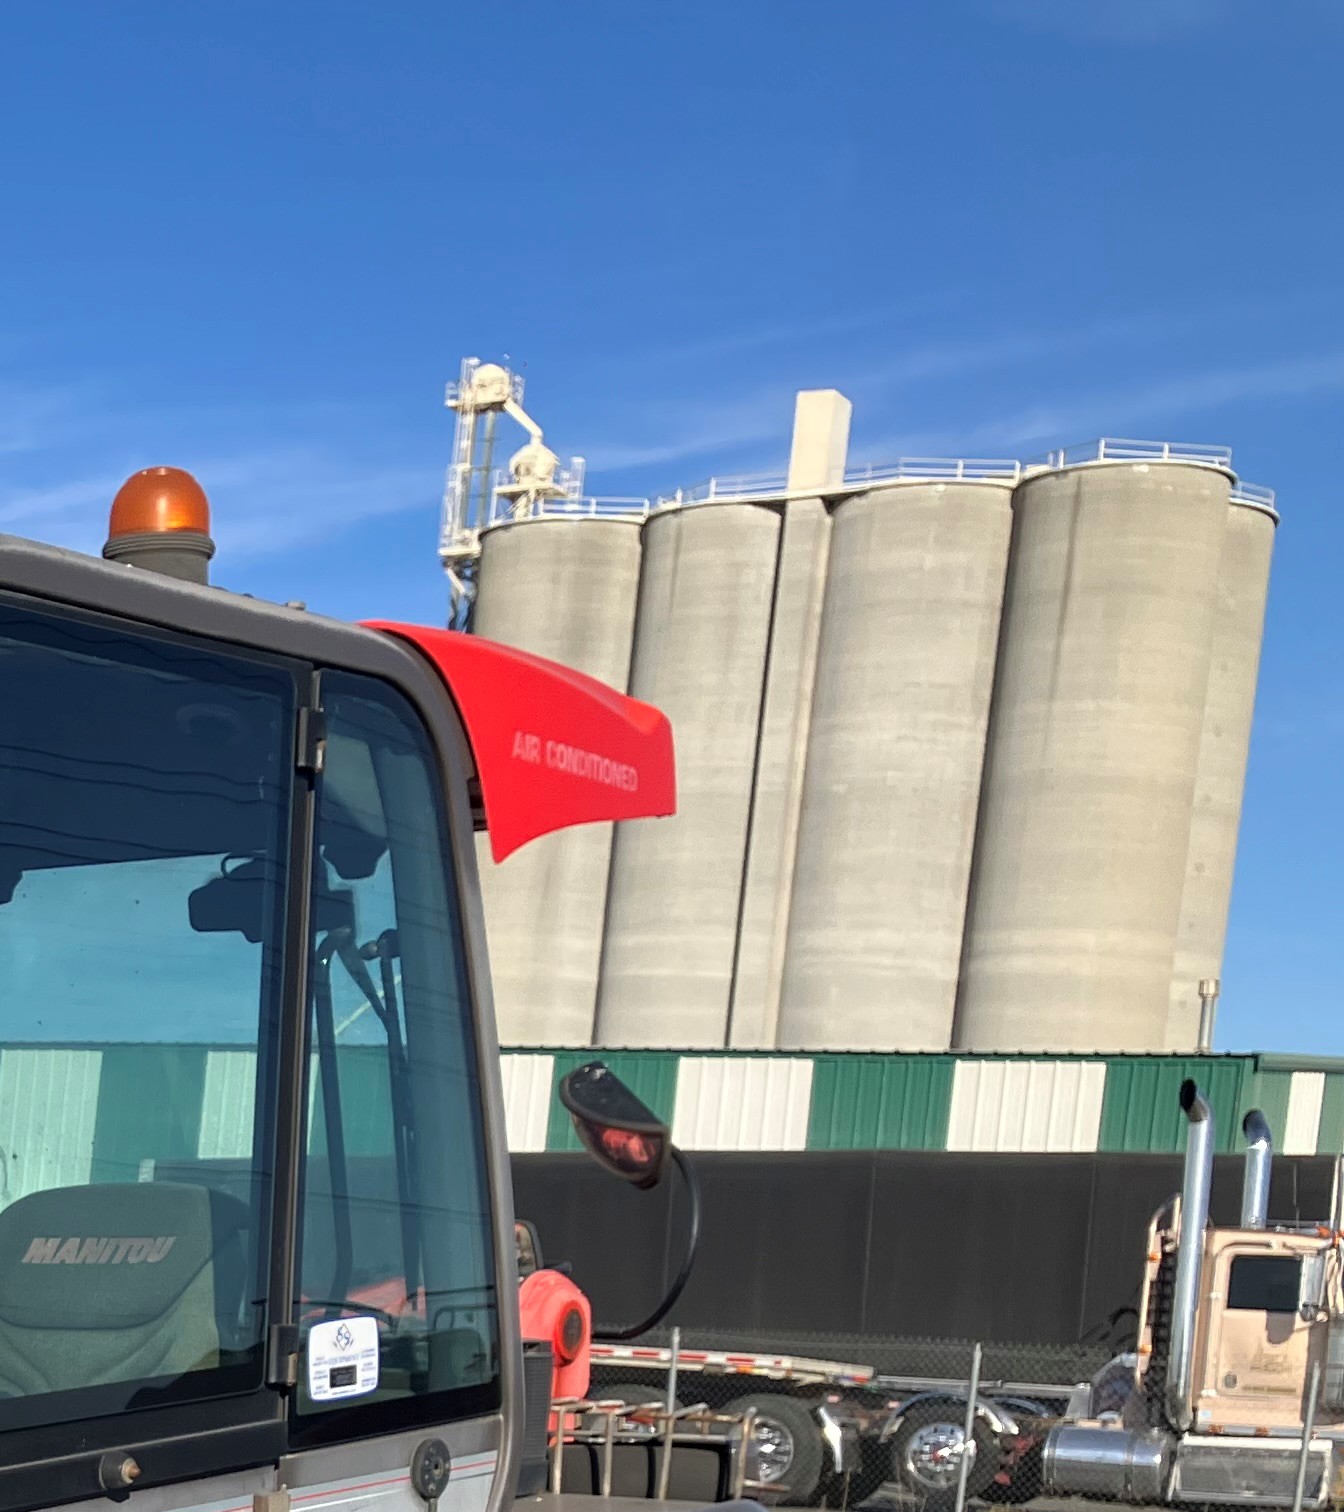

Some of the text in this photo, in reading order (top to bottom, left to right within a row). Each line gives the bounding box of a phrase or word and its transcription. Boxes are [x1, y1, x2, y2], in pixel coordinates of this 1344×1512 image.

[513, 731, 638, 793] AIR CONDITIONED
[21, 1236, 177, 1264] MANITOU
